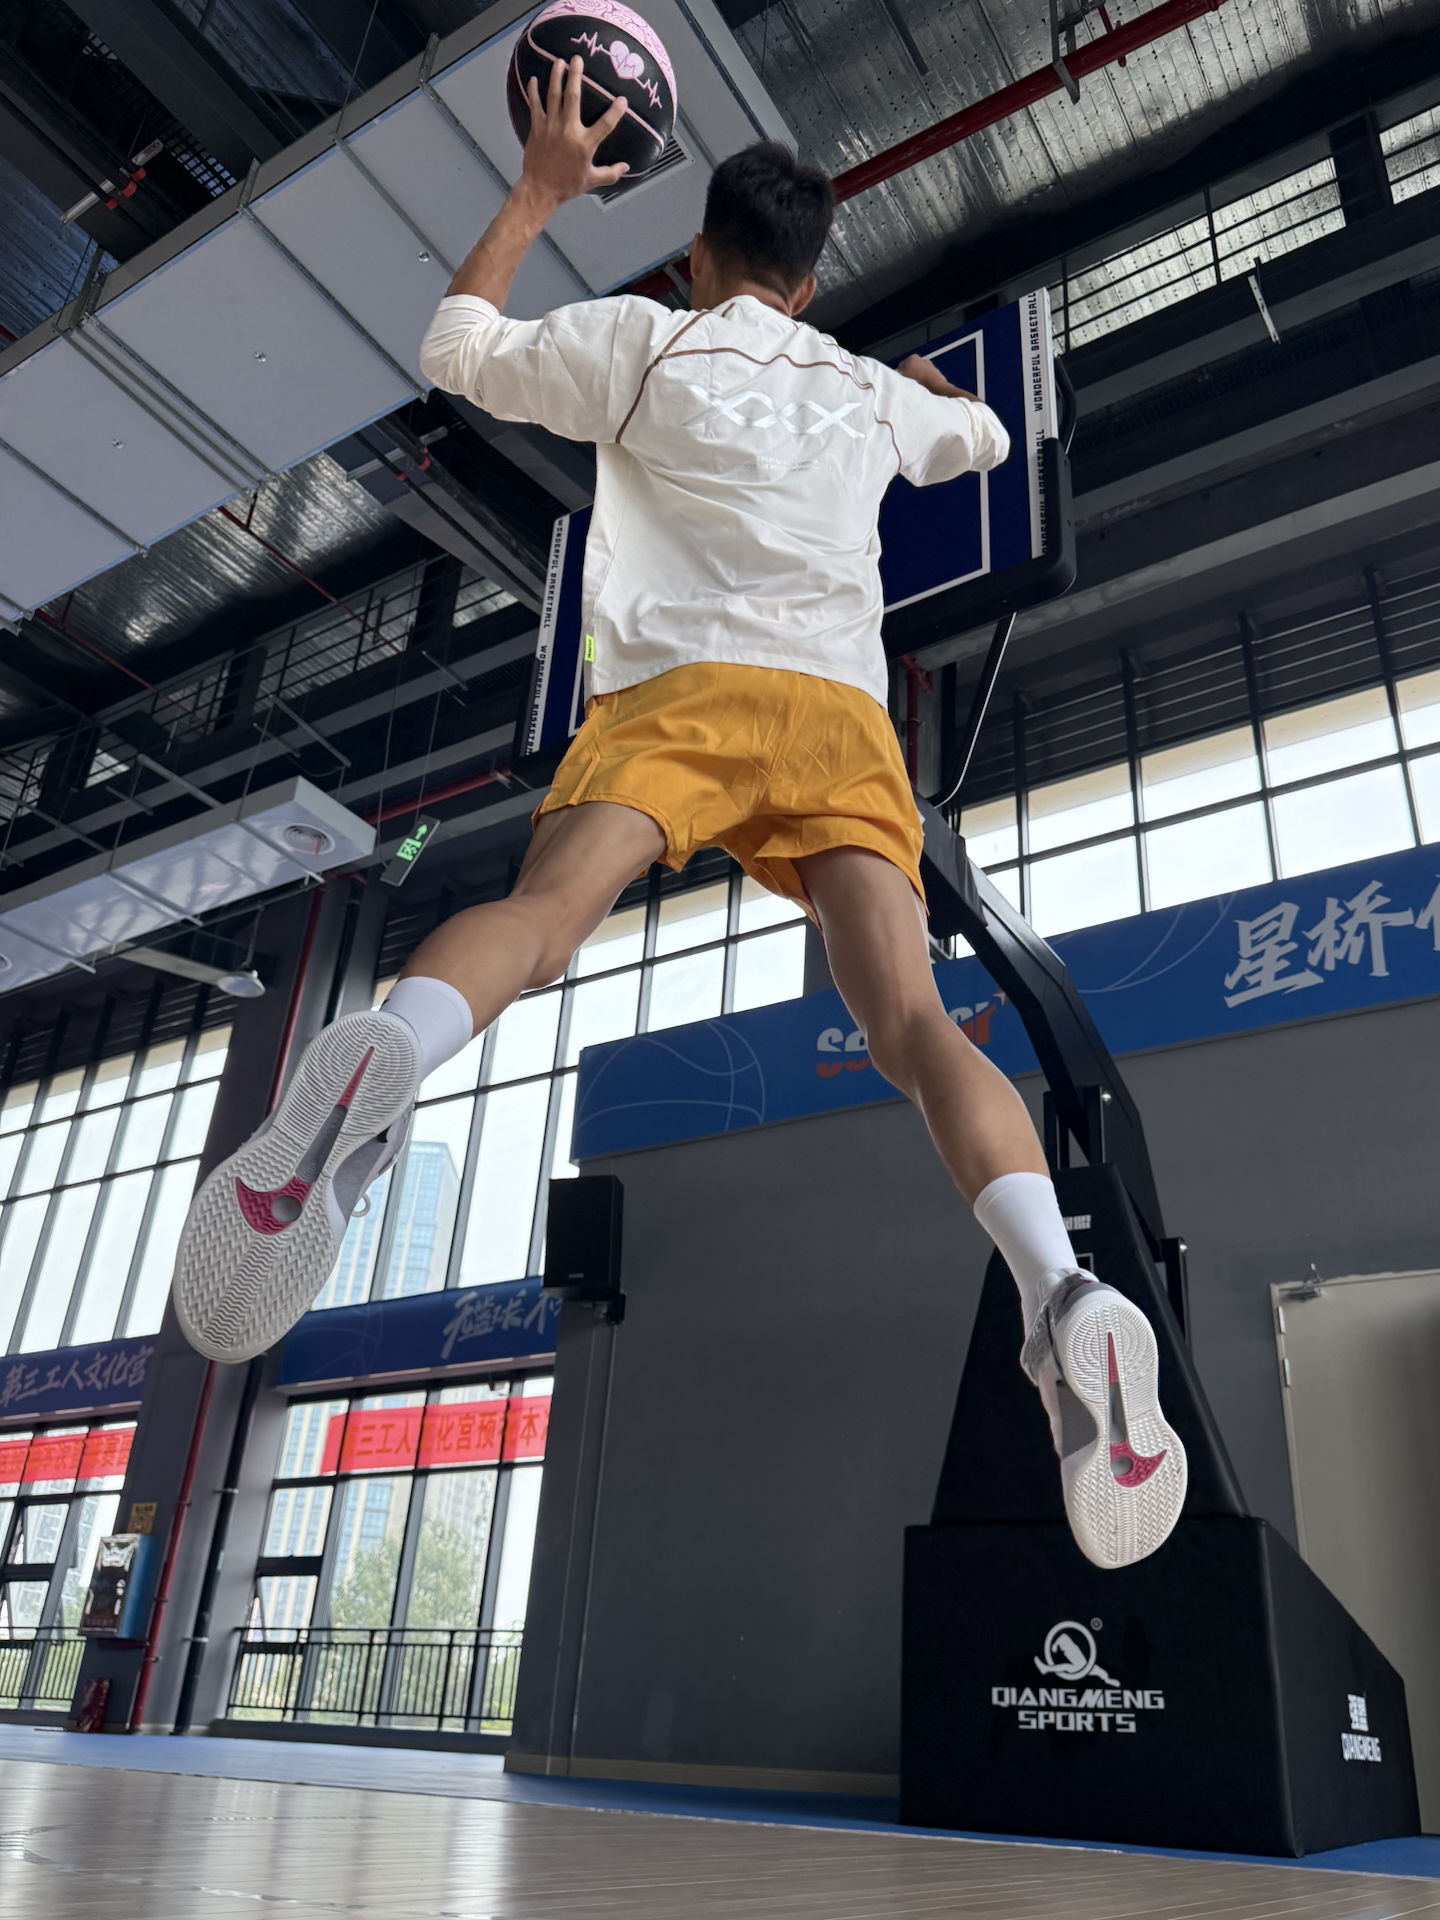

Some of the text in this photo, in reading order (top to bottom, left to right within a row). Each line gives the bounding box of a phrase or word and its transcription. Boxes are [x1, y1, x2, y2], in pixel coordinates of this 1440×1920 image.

[1028, 292, 1043, 412] WONDERFUL BASKETBALL
[543, 519, 564, 629] WONDERFUL BASKETBALL
[1223, 874, 1440, 1008] 星桥
[0, 1345, 155, 1408] 第三工人文化宫
[991, 1686, 1165, 1710] QIANGMENG
[1018, 1710, 1136, 1733] SPORTS
